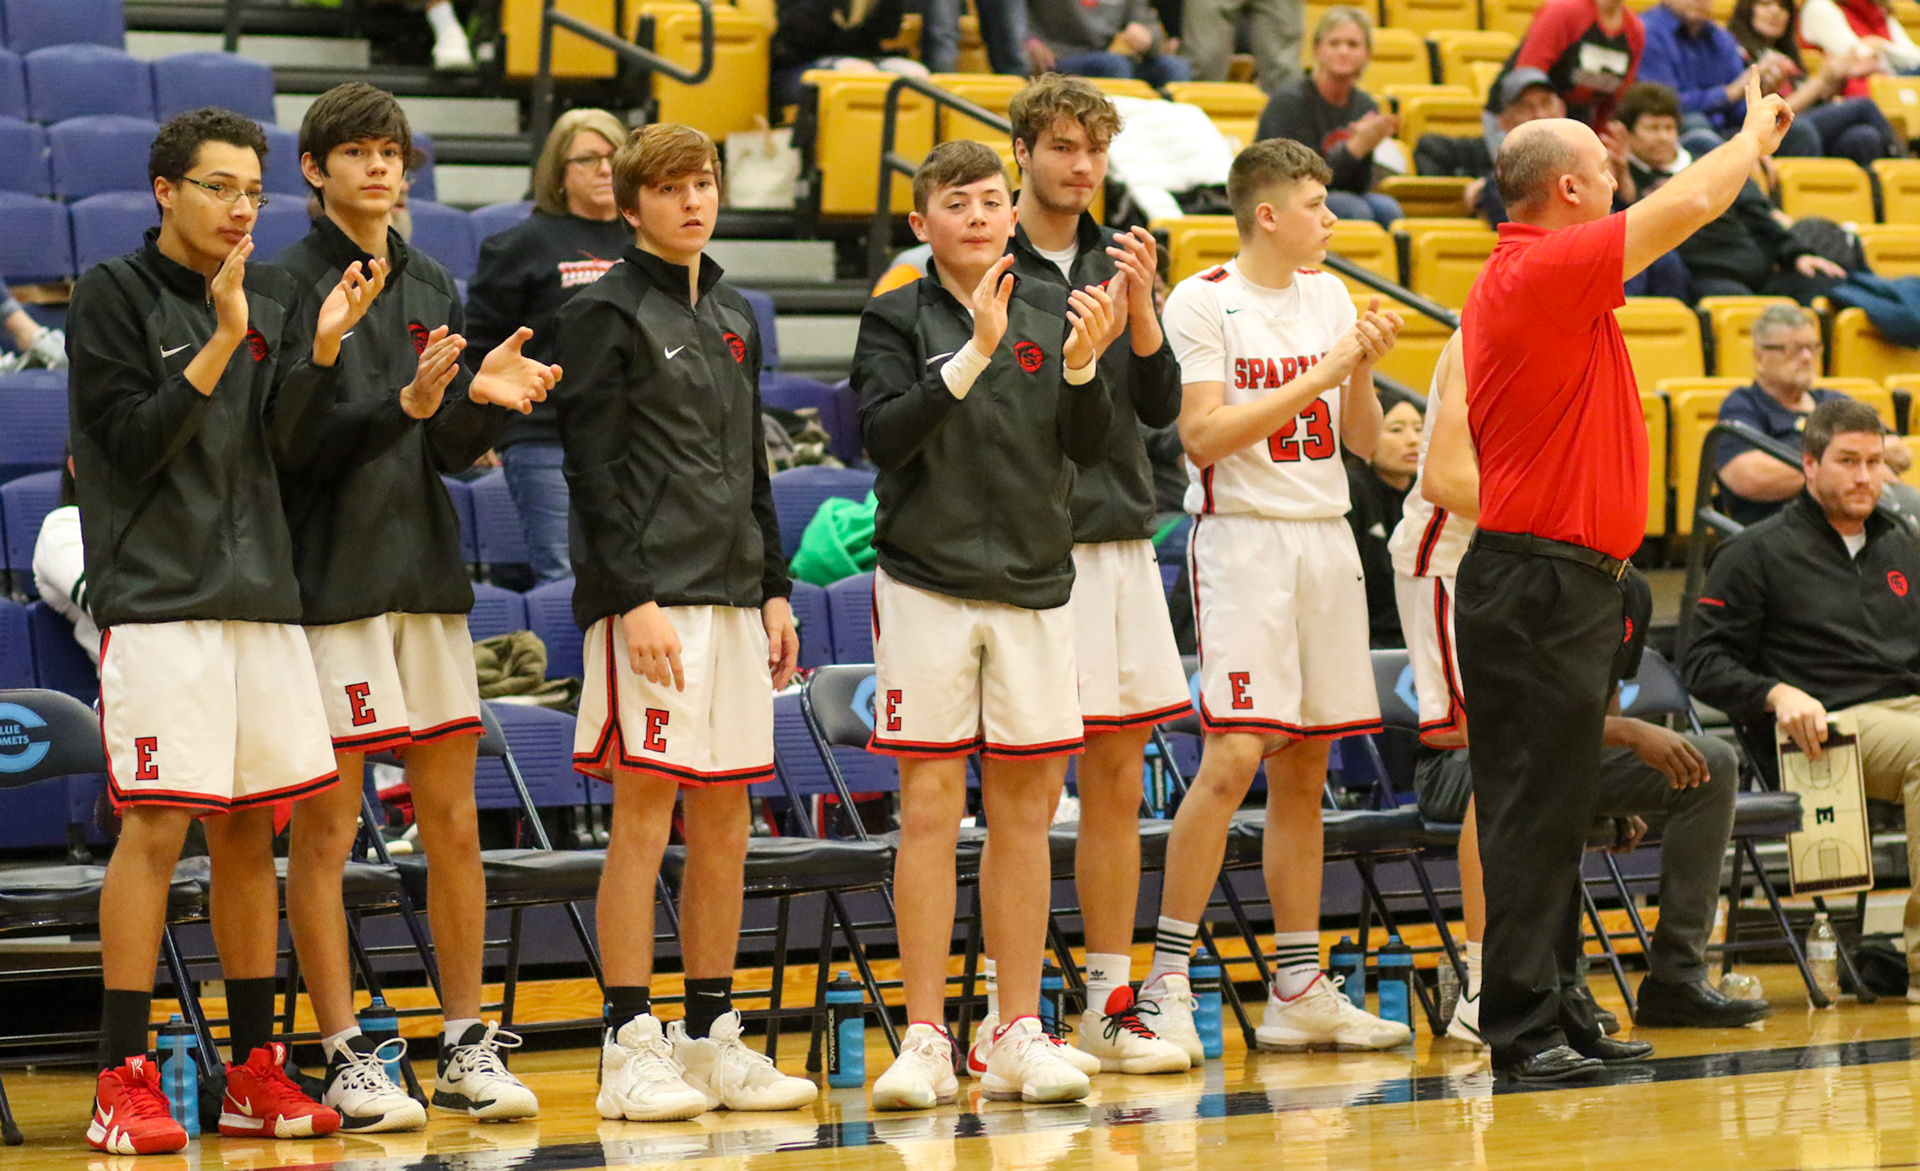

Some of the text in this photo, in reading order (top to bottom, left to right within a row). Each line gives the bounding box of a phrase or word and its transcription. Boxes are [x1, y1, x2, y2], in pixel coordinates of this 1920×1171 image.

[1234, 351, 1328, 389] SPART
[1267, 397, 1335, 463] 23
[345, 681, 376, 727] E
[886, 689, 902, 731] E
[1228, 671, 1253, 710] E
[0, 724, 20, 735] LUE
[643, 707, 669, 753] E
[135, 736, 158, 780] E
[1815, 806, 1834, 824] E
